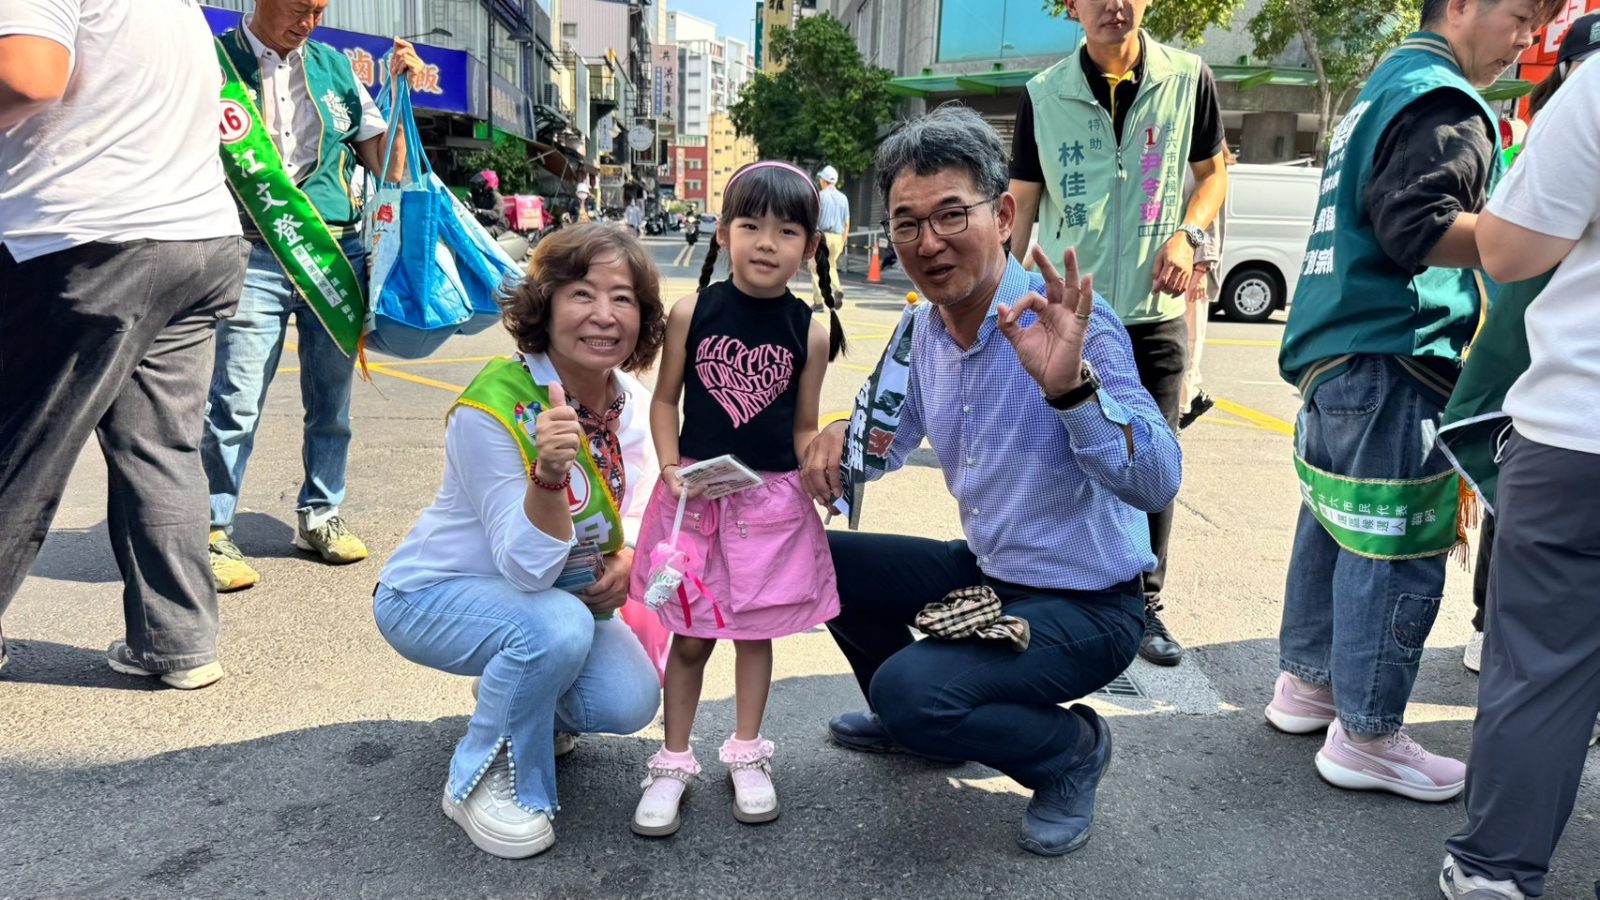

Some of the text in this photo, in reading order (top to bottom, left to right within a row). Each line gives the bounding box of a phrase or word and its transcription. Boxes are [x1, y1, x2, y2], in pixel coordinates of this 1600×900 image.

[344, 46, 443, 94] 滷飯
[1088, 118, 1102, 151] 特助
[1145, 127, 1156, 146] 1
[1058, 140, 1088, 229] 林佳鋒
[1165, 121, 1177, 221] 斗六市長候選人
[231, 148, 304, 248] 江文登
[695, 335, 794, 376] BLACKPINK
